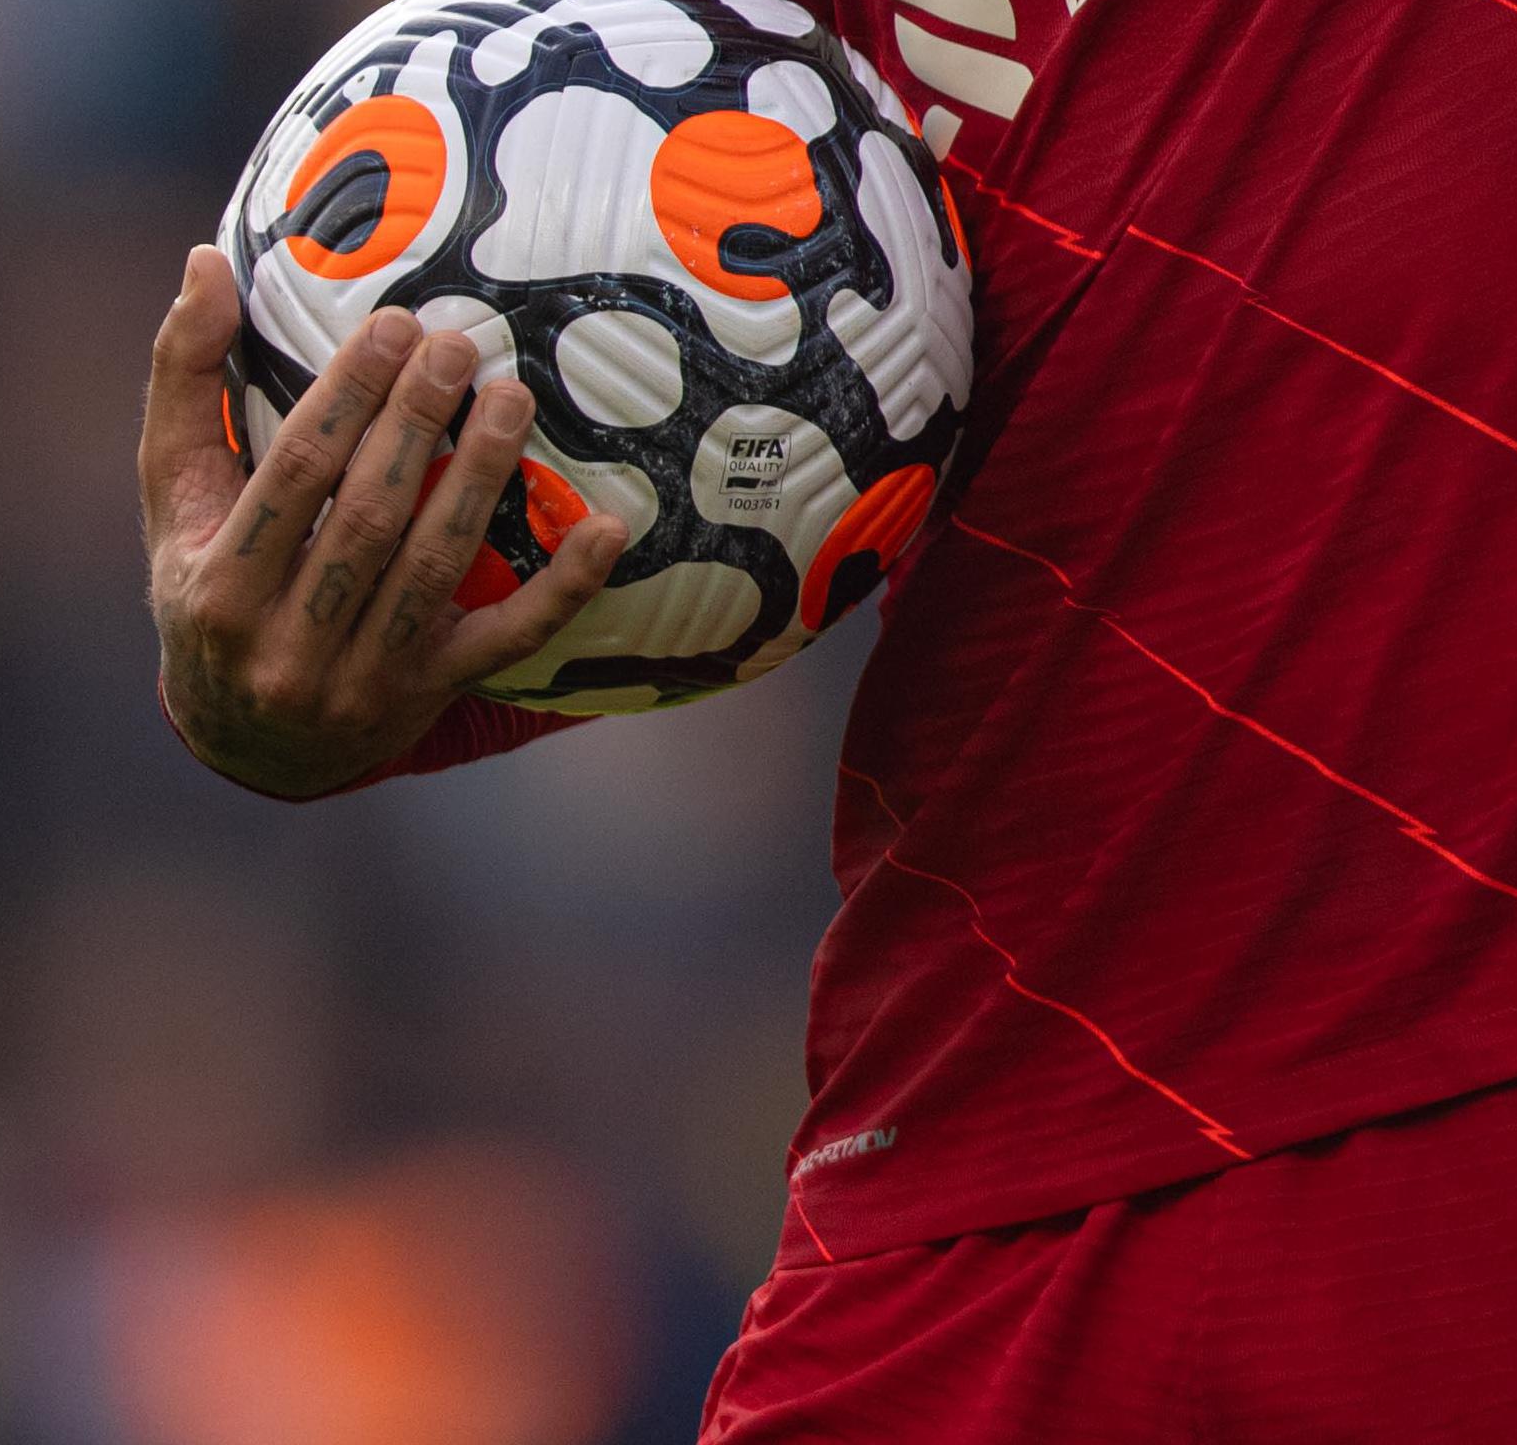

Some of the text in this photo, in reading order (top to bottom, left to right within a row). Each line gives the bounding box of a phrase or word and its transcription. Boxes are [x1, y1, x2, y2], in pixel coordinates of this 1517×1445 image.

[731, 439, 783, 459] FIFA
[729, 460, 782, 472] QUALITY
[728, 497, 780, 510] 1003761
